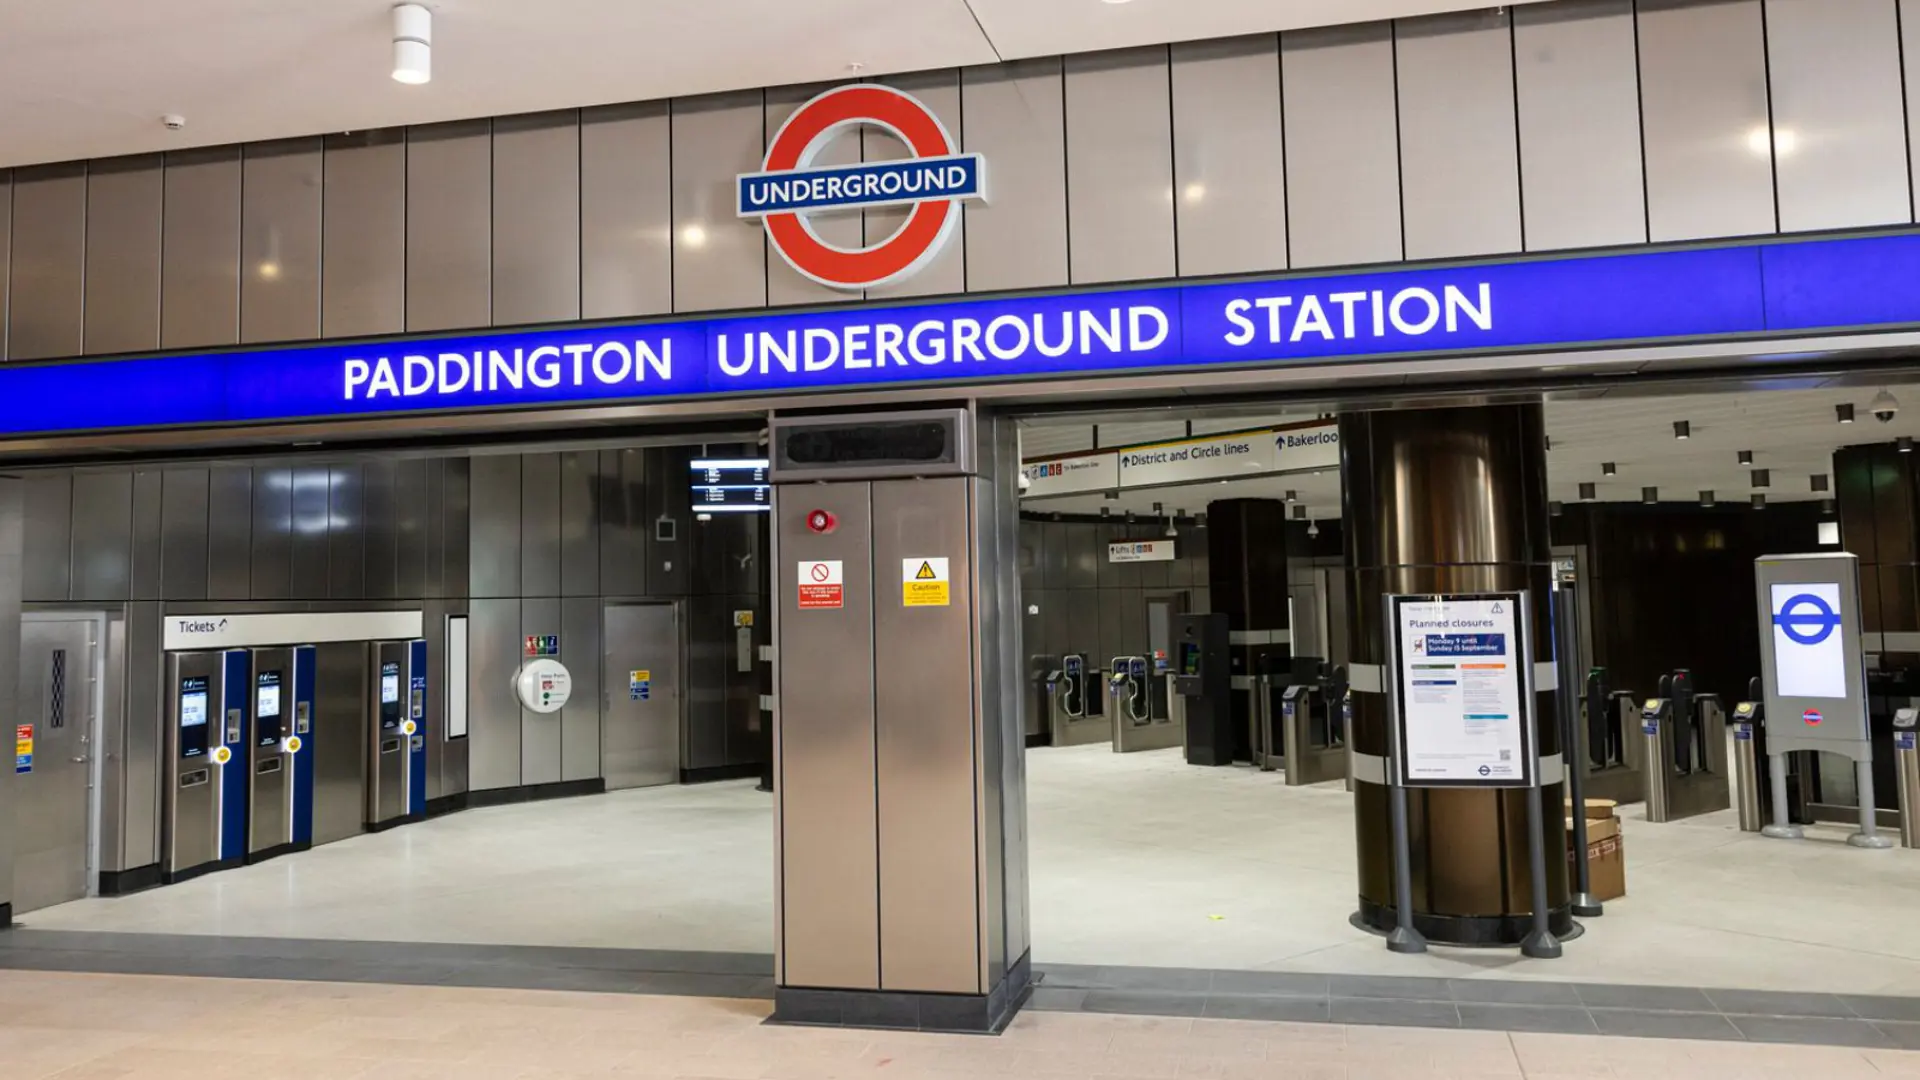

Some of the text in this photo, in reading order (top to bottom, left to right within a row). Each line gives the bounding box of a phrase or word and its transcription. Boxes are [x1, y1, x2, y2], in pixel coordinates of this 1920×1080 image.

[750, 165, 967, 205] UNDERGROUND
[343, 282, 1493, 400] PADDINGTON UNDERGROUND STATION
[1287, 431, 1338, 447] Bakerloo
[1131, 442, 1249, 467] District and Circle lines
[911, 583, 940, 592] Caution
[179, 620, 216, 633] Tickets
[1409, 619, 1494, 629] Planned closures
[1427, 637, 1454, 646] Monday
[1461, 637, 1478, 645] until
[1428, 645, 1453, 653] Sunday
[1461, 644, 1499, 653] September
